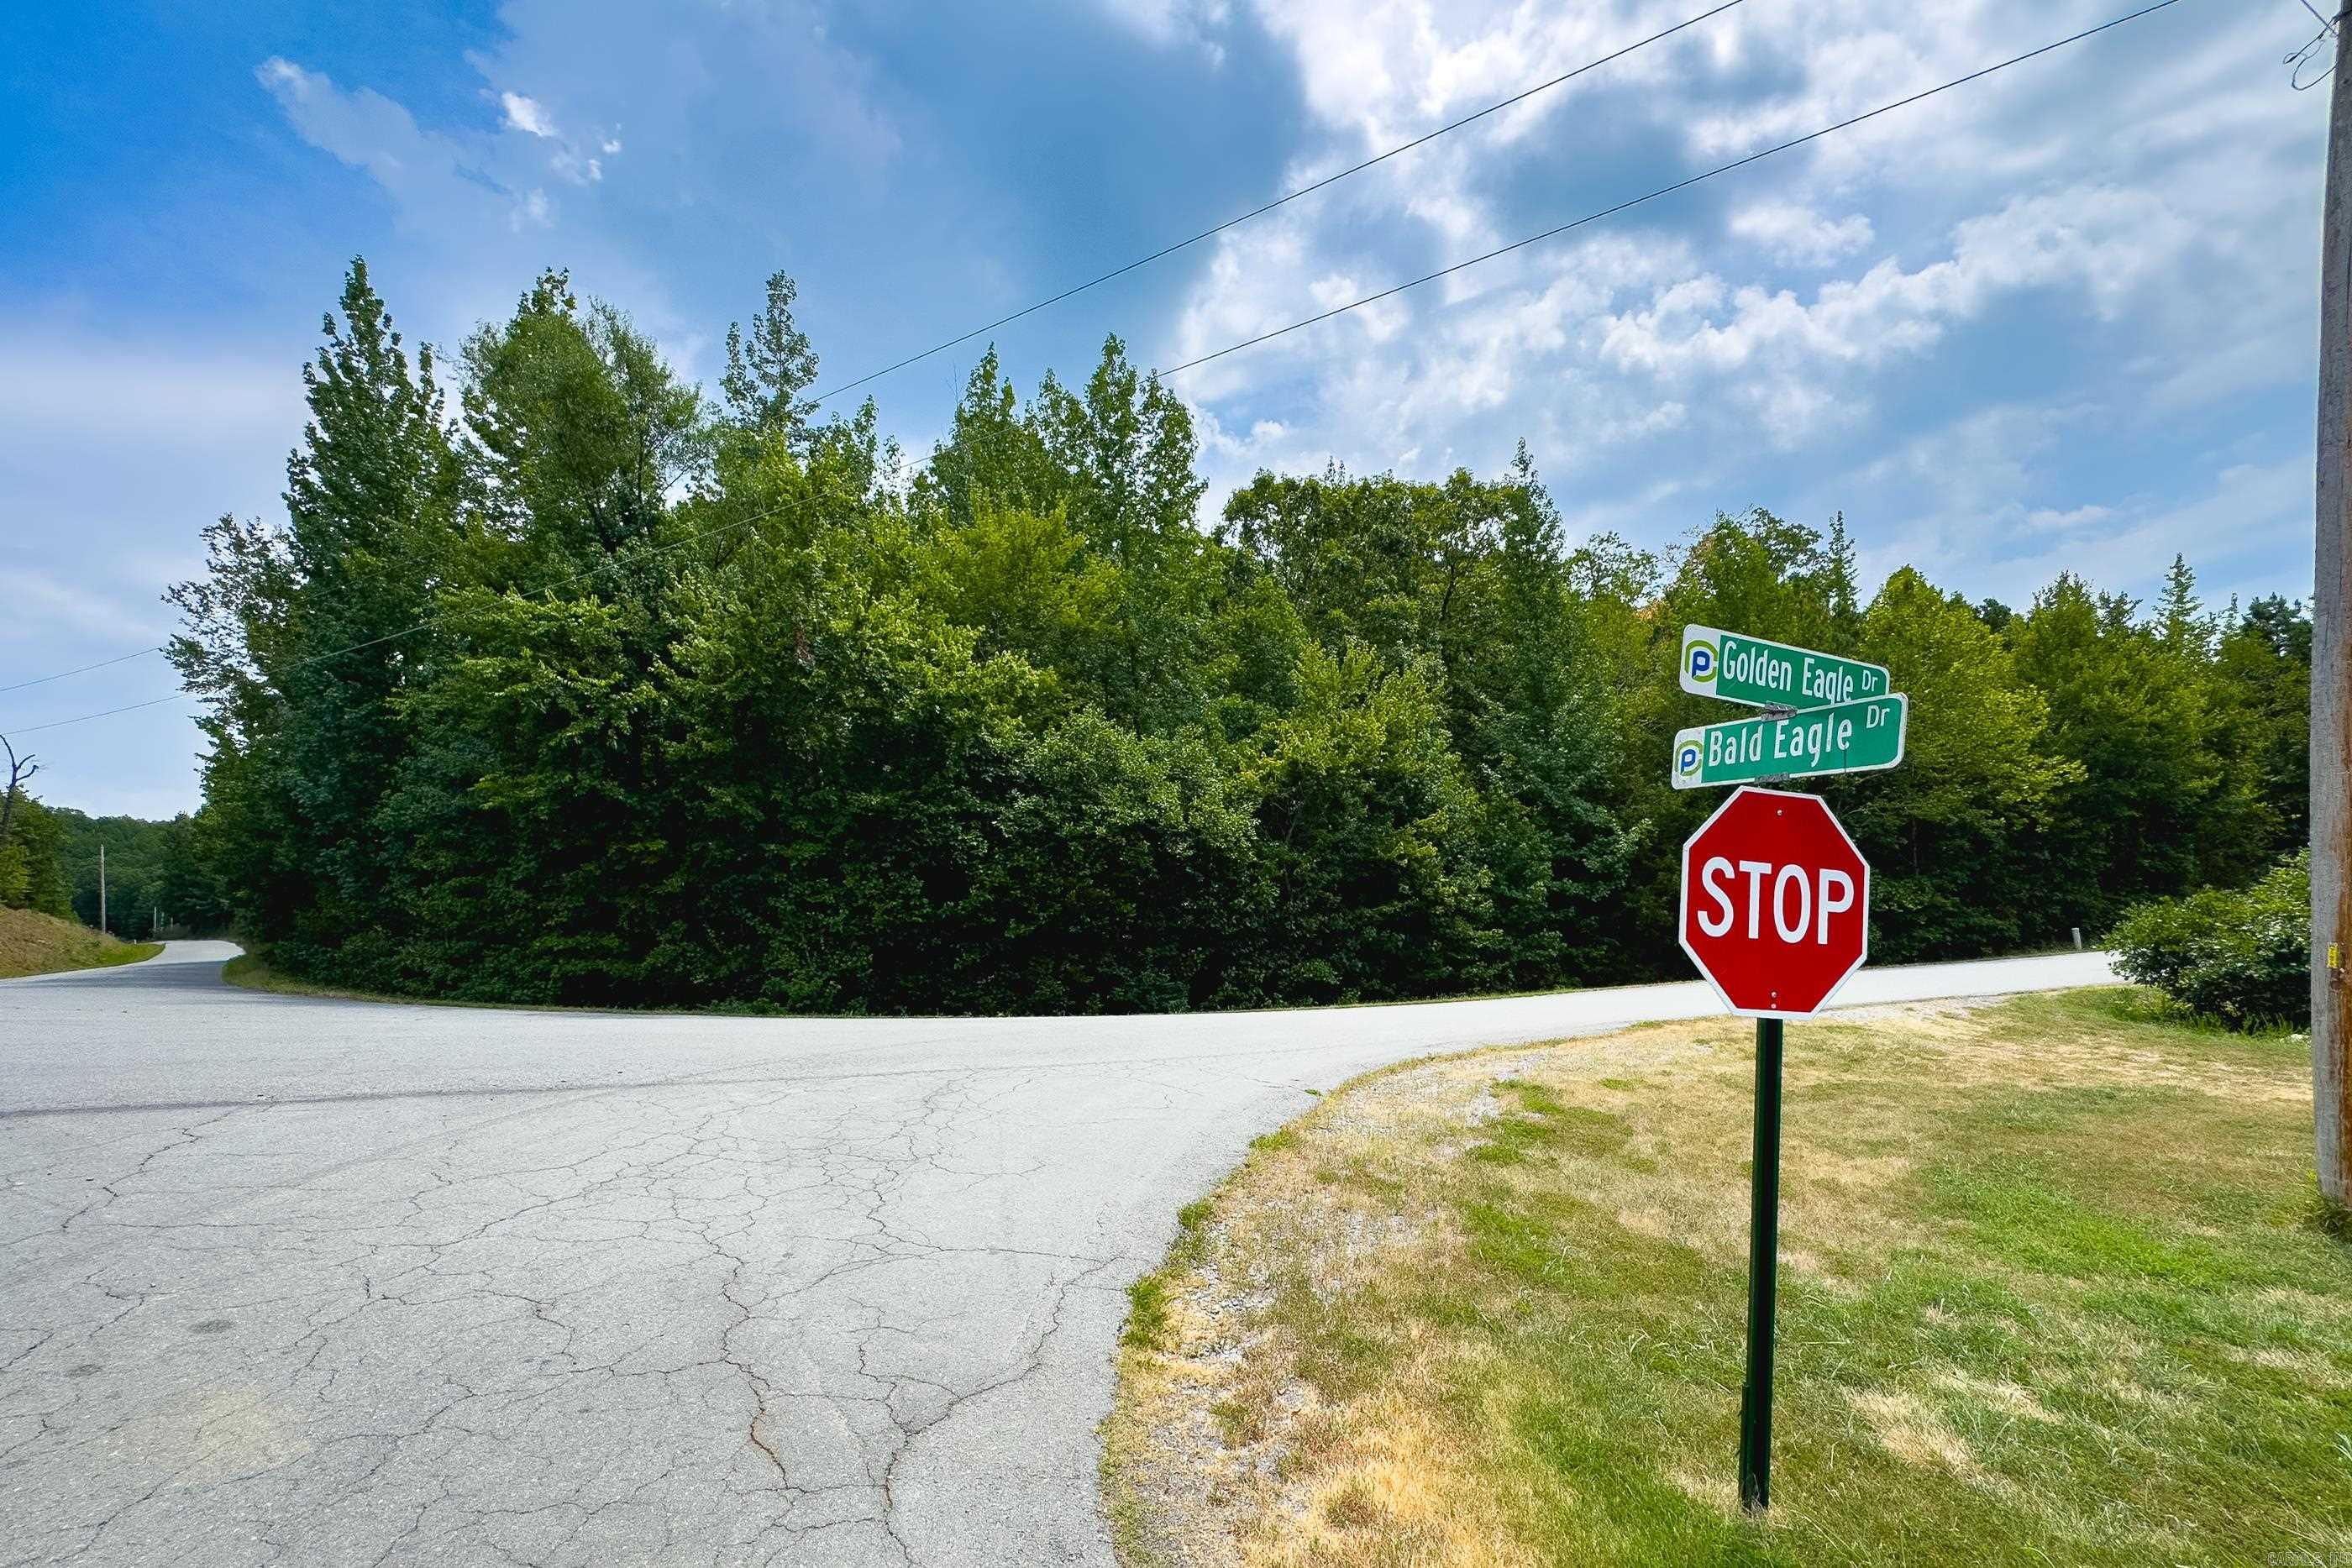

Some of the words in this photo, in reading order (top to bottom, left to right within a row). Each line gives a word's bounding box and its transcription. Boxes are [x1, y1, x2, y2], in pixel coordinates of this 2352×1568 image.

[1723, 640, 1792, 692] Golden
[1802, 657, 1854, 704] Eagle
[1861, 669, 1878, 692] Dr
[1708, 724, 1763, 767] Bald
[1773, 712, 1853, 768] Eagle
[1866, 705, 1890, 729] Dr
[1697, 856, 1855, 945] STOP
